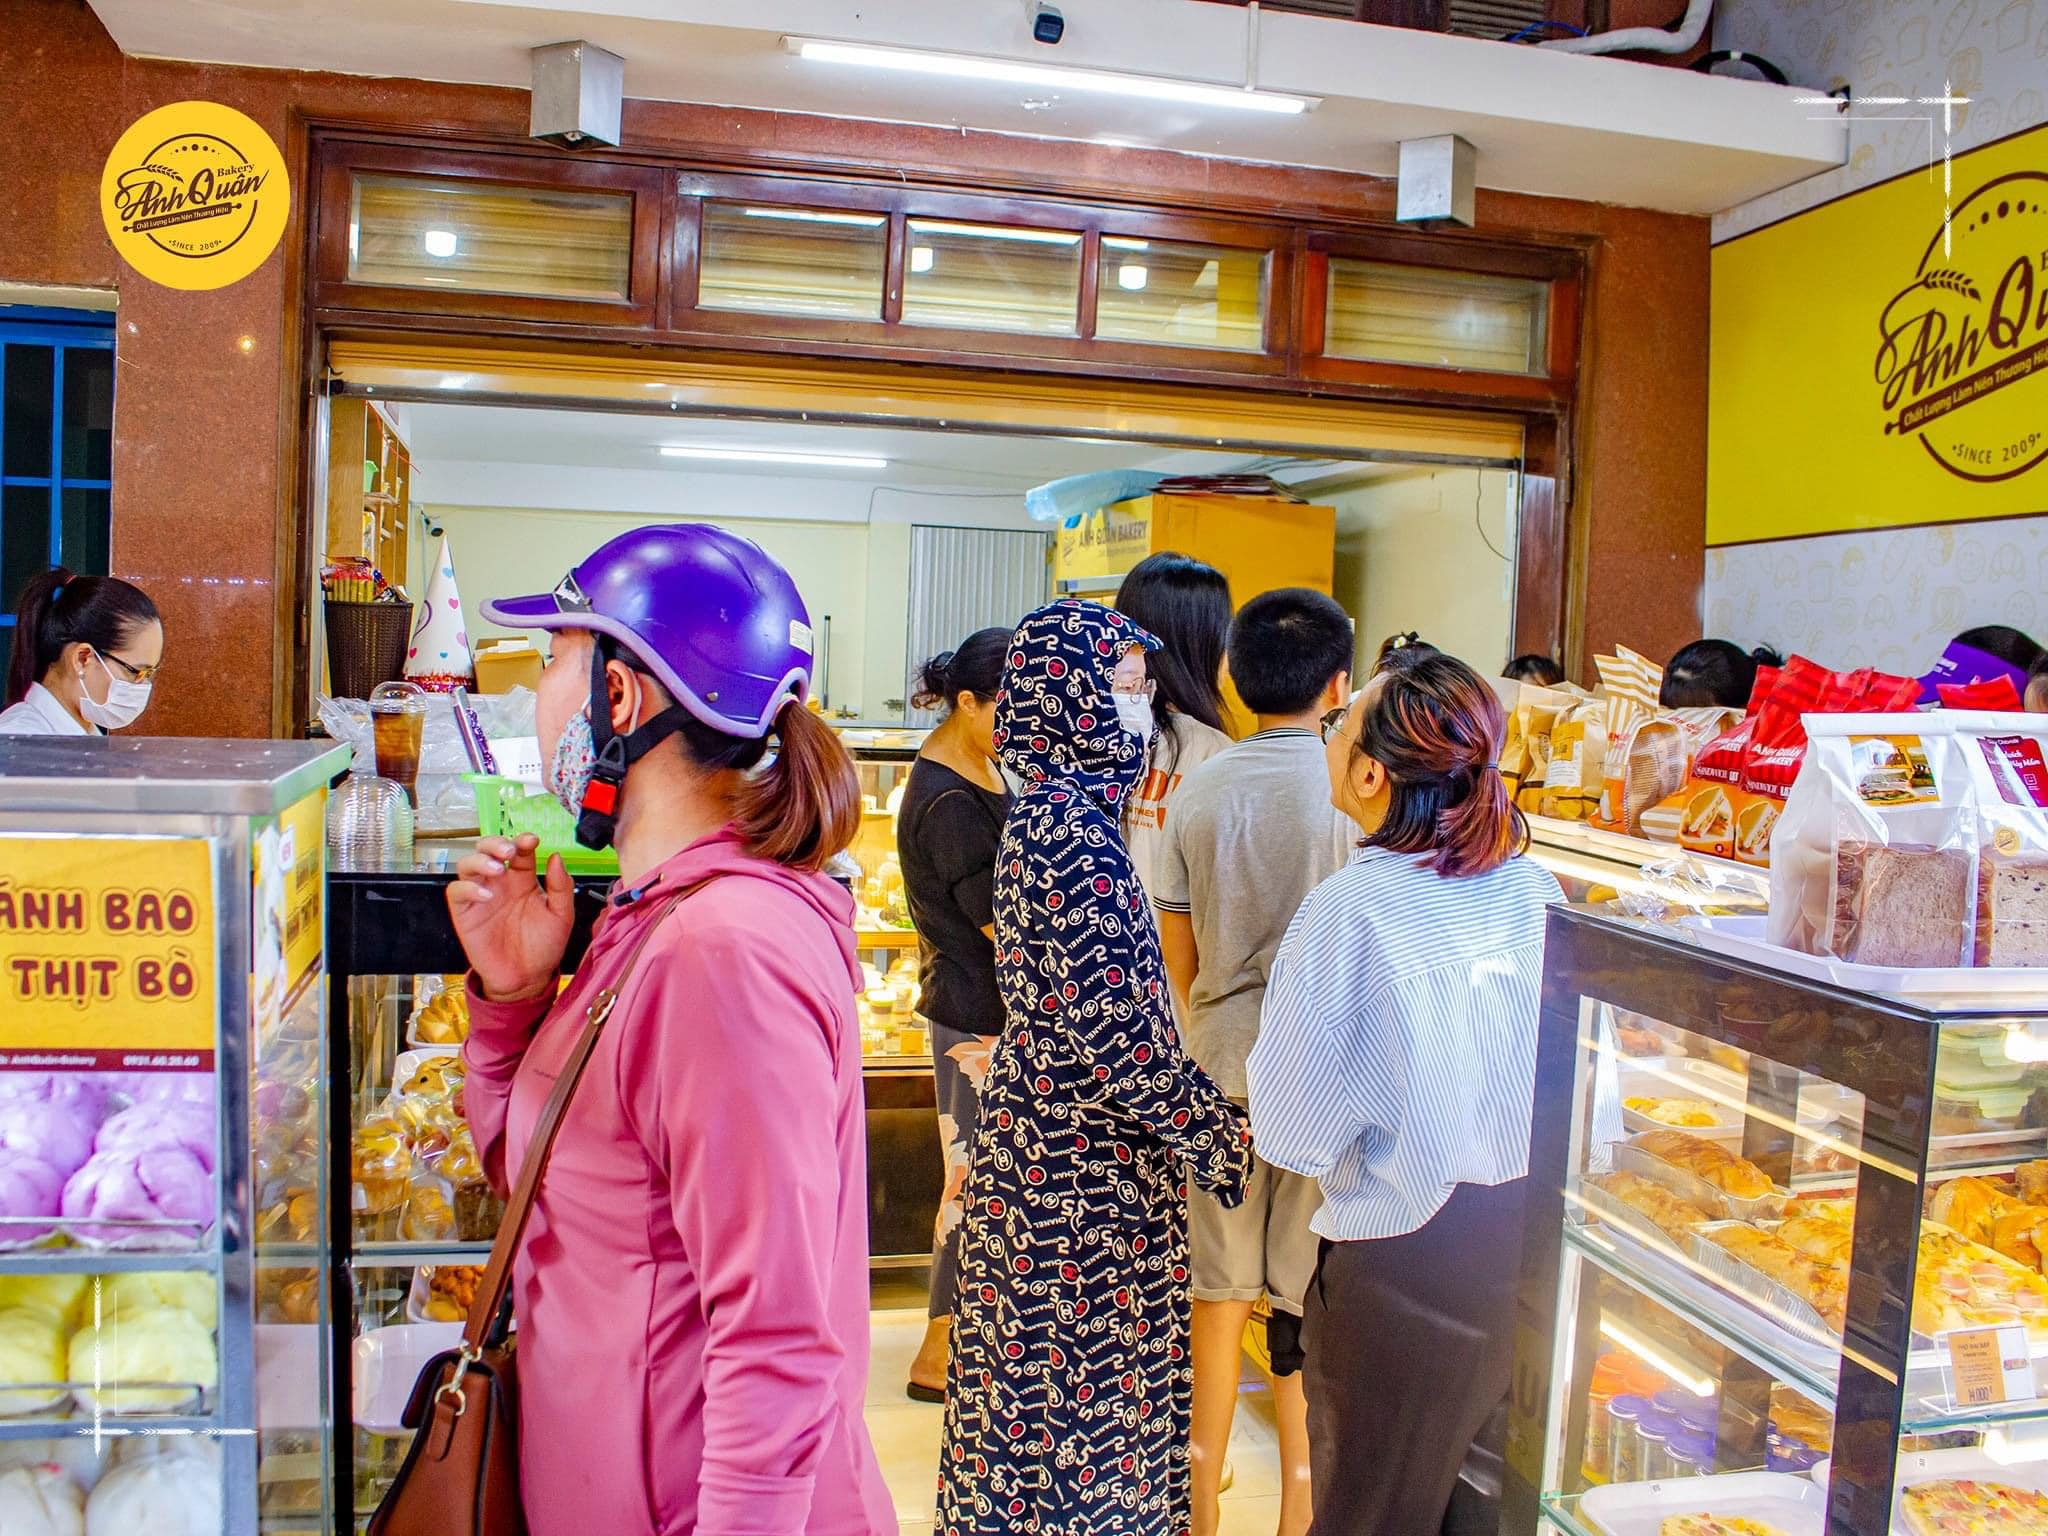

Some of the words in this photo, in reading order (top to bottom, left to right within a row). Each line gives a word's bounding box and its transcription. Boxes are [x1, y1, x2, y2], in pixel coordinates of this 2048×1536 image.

[1956, 443, 1993, 465] SINCE
[2002, 433, 2037, 462] 2009
[105, 892, 194, 932] BAO
[1067, 925, 1097, 951] CHANEL
[12, 959, 118, 1006] THỊT
[138, 950, 194, 997] BÒ
[1089, 1419, 1120, 1439] CHANEL
